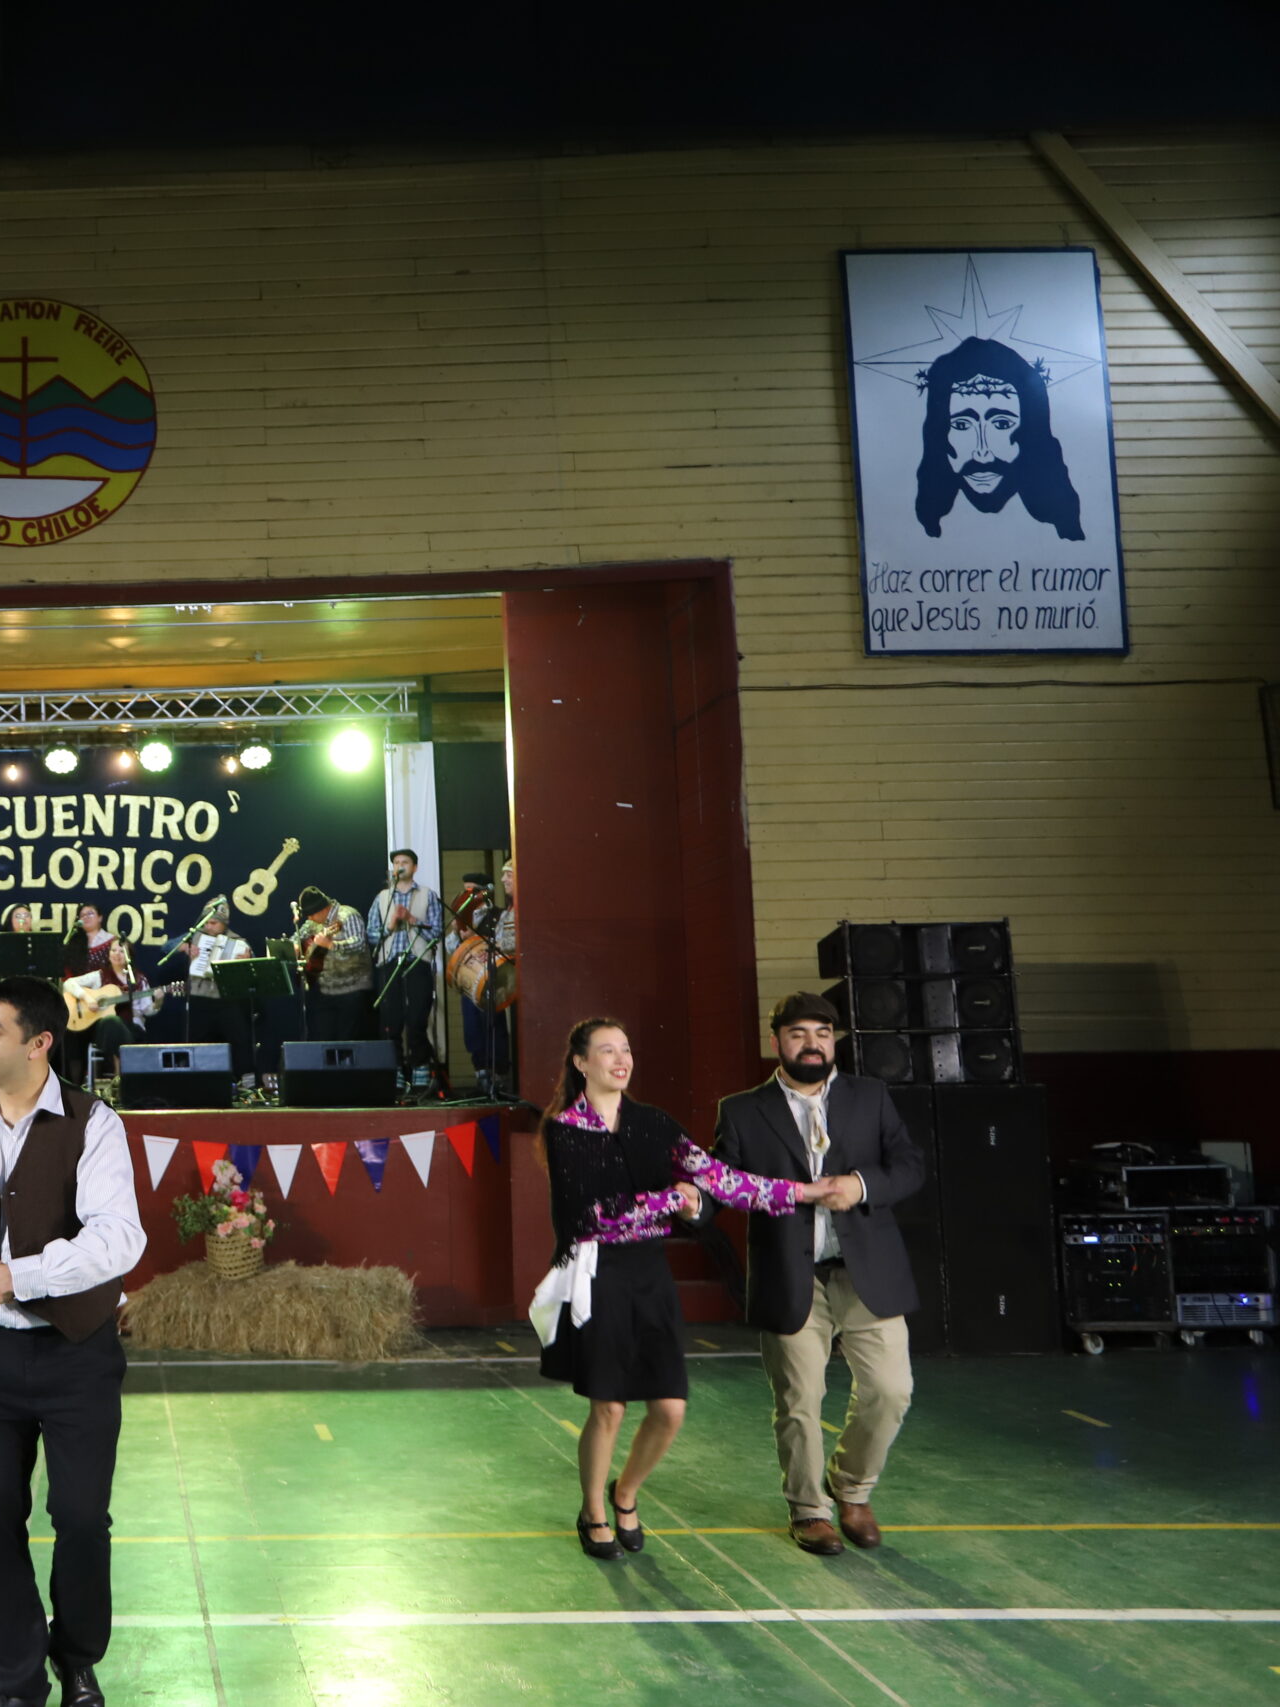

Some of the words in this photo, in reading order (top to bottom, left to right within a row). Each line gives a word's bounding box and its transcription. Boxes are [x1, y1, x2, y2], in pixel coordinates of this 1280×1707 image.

[73, 313, 134, 367] FREIRE
[22, 497, 109, 544] CHILOE
[869, 561, 913, 594] Haz
[920, 568, 993, 593] correr
[998, 561, 1023, 593] el
[1031, 566, 1112, 593] rumor
[871, 605, 909, 648] que
[910, 598, 981, 632] Jesús
[997, 605, 1028, 630] no
